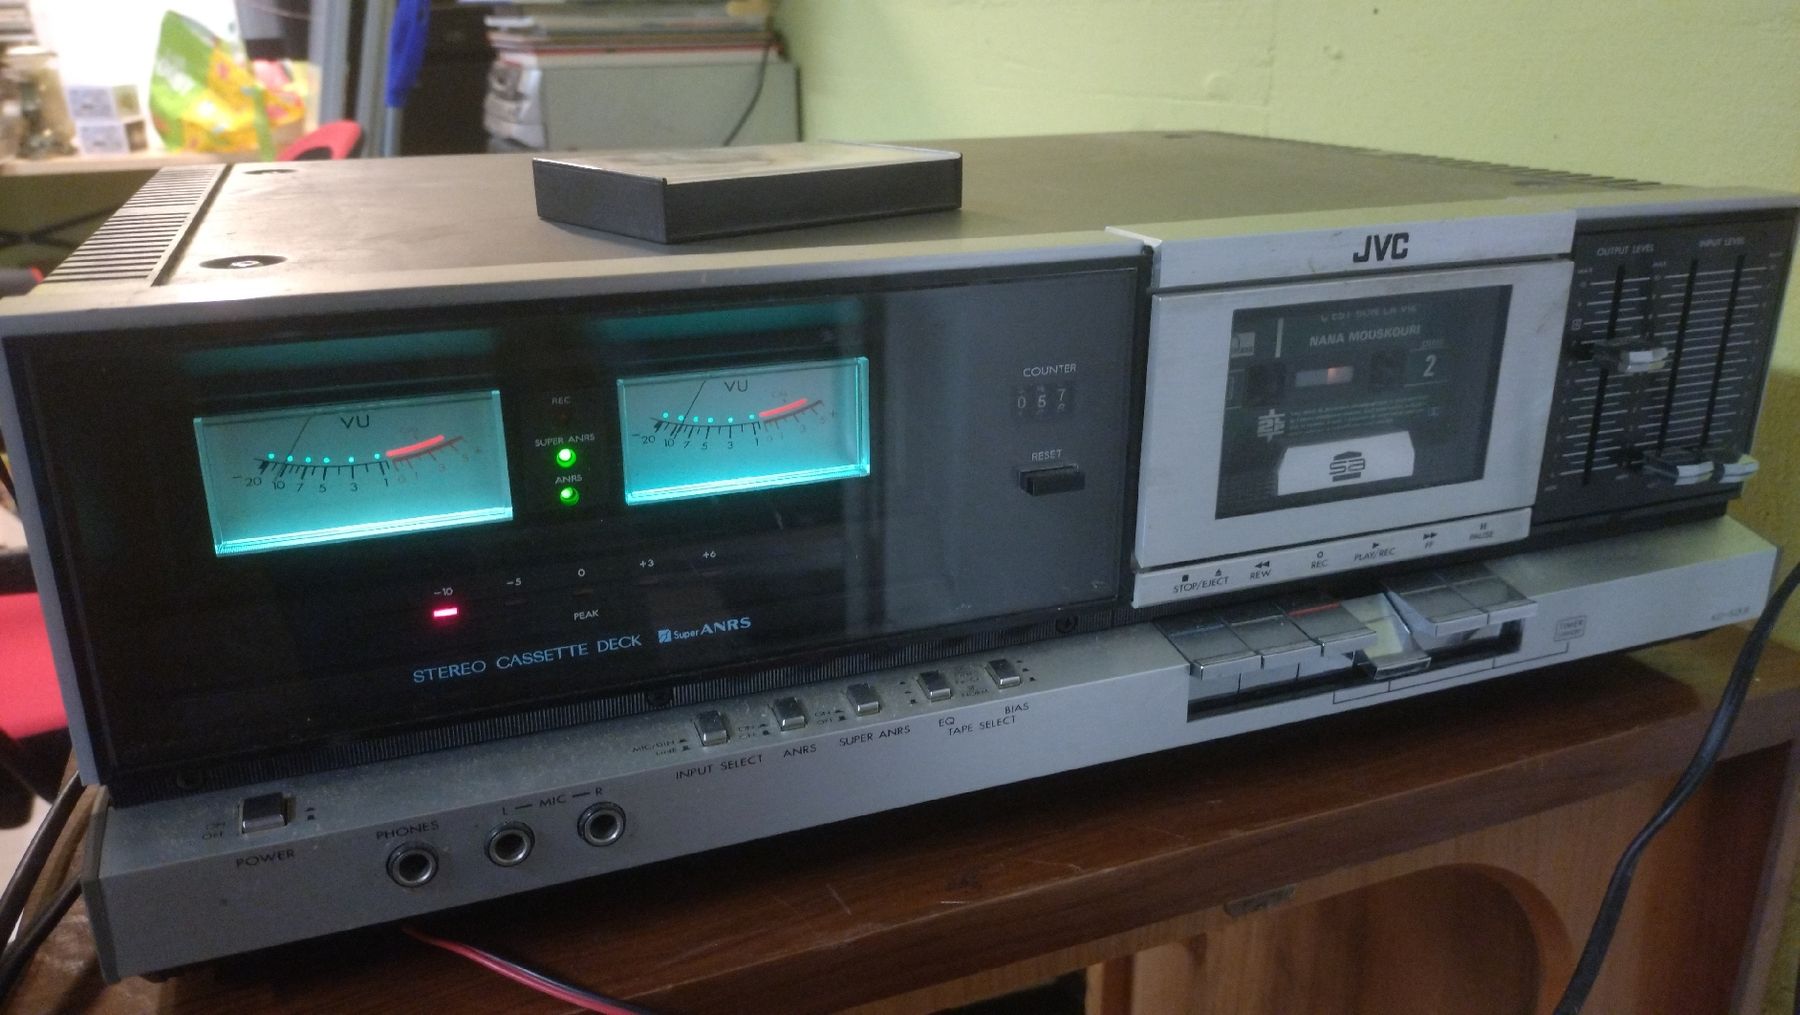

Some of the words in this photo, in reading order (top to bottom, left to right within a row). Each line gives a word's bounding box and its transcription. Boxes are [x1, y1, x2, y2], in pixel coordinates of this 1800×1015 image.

[1353, 232, 1409, 263] JVC
[1597, 245, 1630, 257] OUTPUT
[1310, 333, 1345, 347] NANA
[1349, 324, 1421, 342] MOUSKOURI
[1023, 363, 1077, 377] COUNTER
[1423, 354, 1437, 377] 2
[724, 380, 748, 393] VU
[552, 396, 571, 405] REC
[340, 415, 370, 429] VU
[534, 436, 565, 448] SUPER
[568, 433, 595, 443] ANRS
[1031, 449, 1063, 461] RESET
[555, 474, 583, 485] ANRS
[273, 481, 286, 491] 10
[319, 483, 327, 493] 5
[351, 482, 358, 492] 3
[703, 550, 717, 559] +6
[1354, 547, 1396, 561] PLAY/REC
[640, 558, 655, 568] +3
[1311, 559, 1329, 569] REC
[577, 568, 586, 577] 0
[1250, 569, 1271, 579] REW
[1173, 576, 1230, 594] STOP/EJECT
[573, 609, 599, 621] PEAK
[413, 660, 487, 684] STEREO
[496, 643, 589, 670] CASSETTE
[597, 634, 642, 653] DECK
[700, 617, 752, 636] ANRS
[1005, 702, 1030, 715] BIAS
[938, 717, 955, 728] EQ
[948, 723, 973, 736] TAPE
[979, 715, 1016, 730] SELECT
[839, 732, 874, 748] SUPER
[879, 724, 911, 740] ANRS
[783, 743, 817, 758] ANRS
[676, 765, 712, 780] INPUT
[720, 754, 764, 771] SELECT
[539, 794, 566, 809] MIC
[595, 787, 604, 797] R
[376, 820, 440, 841] PHONES
[236, 848, 295, 868] POWER
